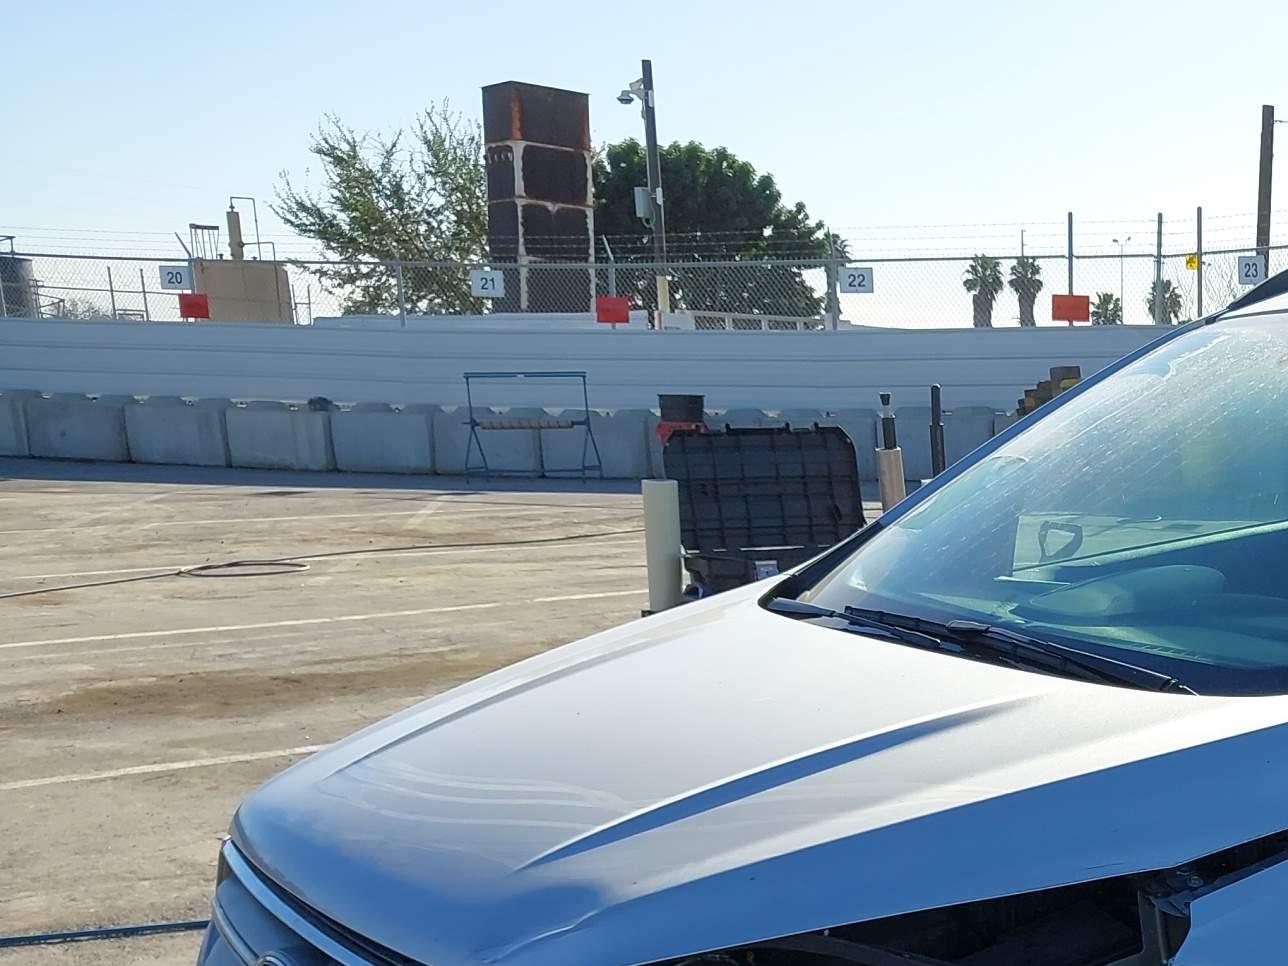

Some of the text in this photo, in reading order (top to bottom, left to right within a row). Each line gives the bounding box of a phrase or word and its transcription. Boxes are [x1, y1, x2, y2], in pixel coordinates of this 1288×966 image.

[1244, 262, 1258, 278] 23
[166, 271, 183, 285] 20
[480, 276, 496, 290] 21
[847, 273, 866, 288] 22
